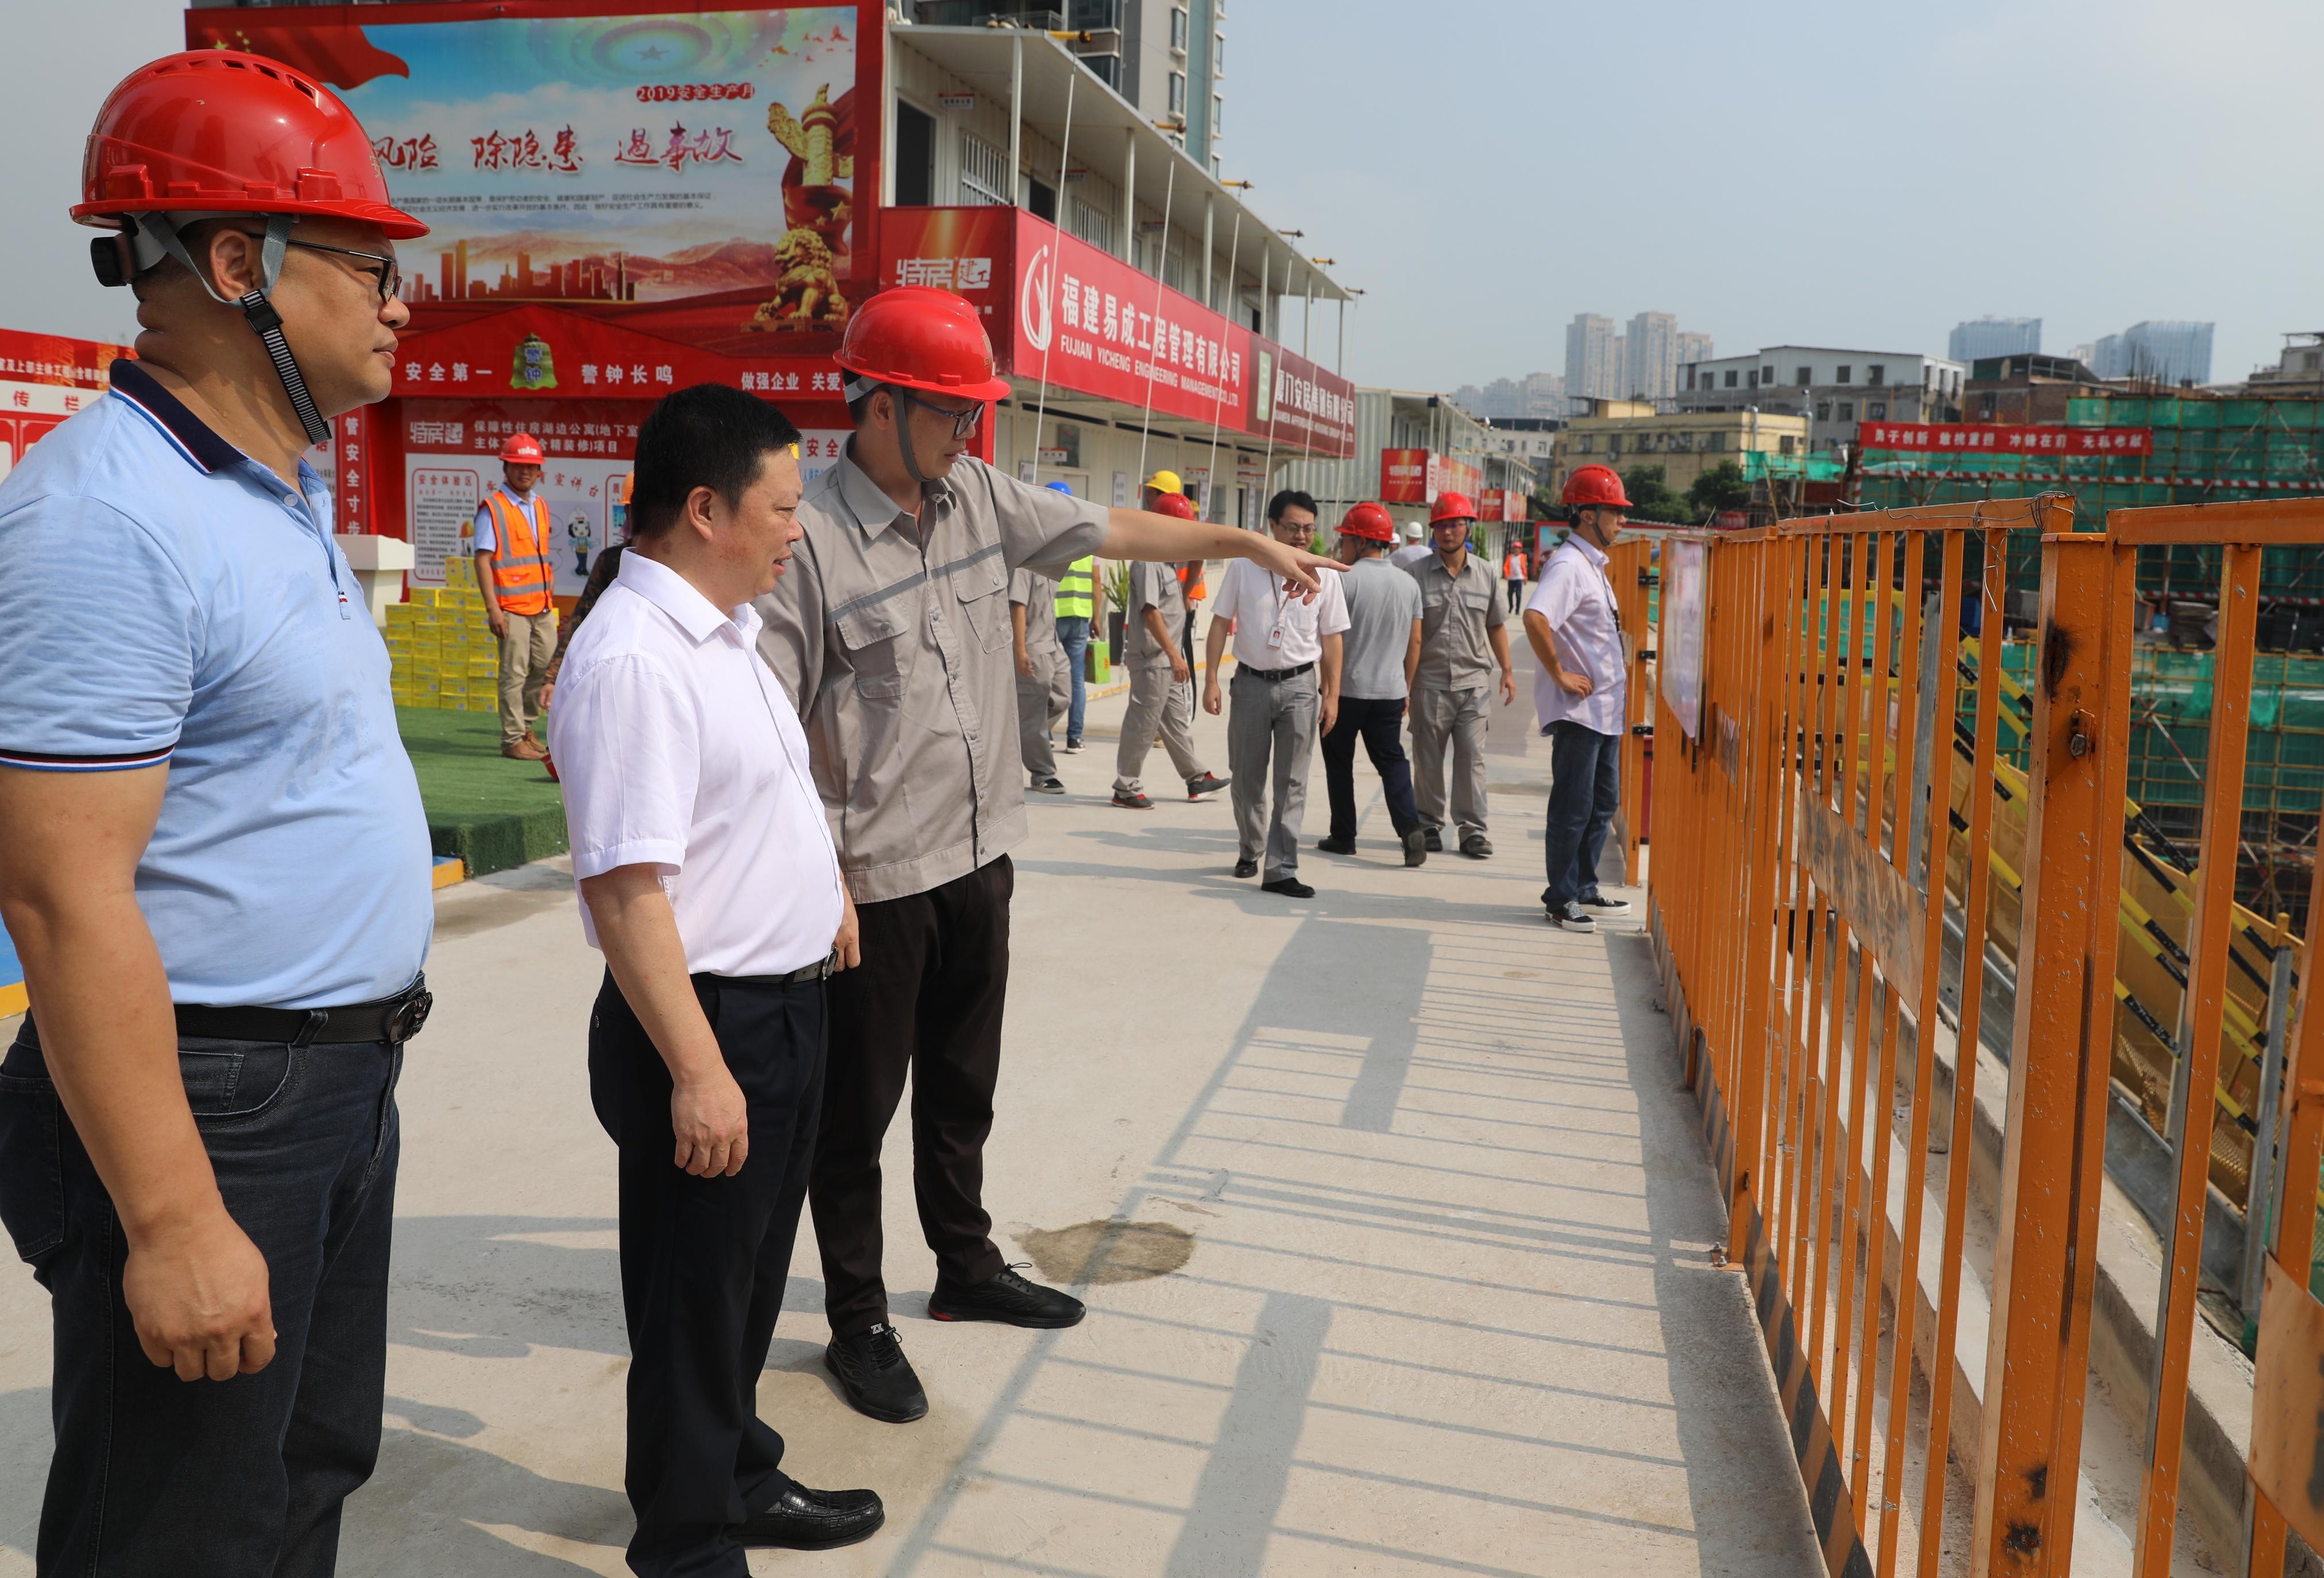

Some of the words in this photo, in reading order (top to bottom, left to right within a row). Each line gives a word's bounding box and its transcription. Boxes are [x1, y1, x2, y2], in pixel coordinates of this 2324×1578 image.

[637, 83, 754, 100] 2019安全生产月
[370, 133, 440, 171] 风险
[470, 123, 584, 172] 除隐患
[1062, 272, 1240, 388] 福建易成工程管理有限公司
[524, 347, 543, 382] 警钟
[1061, 334, 1092, 361] FUJIAN
[1097, 346, 1131, 373] YICHENG
[405, 362, 493, 382] 安全第一
[582, 363, 674, 385] 警钟长鸣
[741, 372, 800, 391] 做强企业
[811, 372, 845, 392] 关爱
[474, 436, 617, 453] 主体含精装修)项目
[806, 438, 839, 458] 安全
